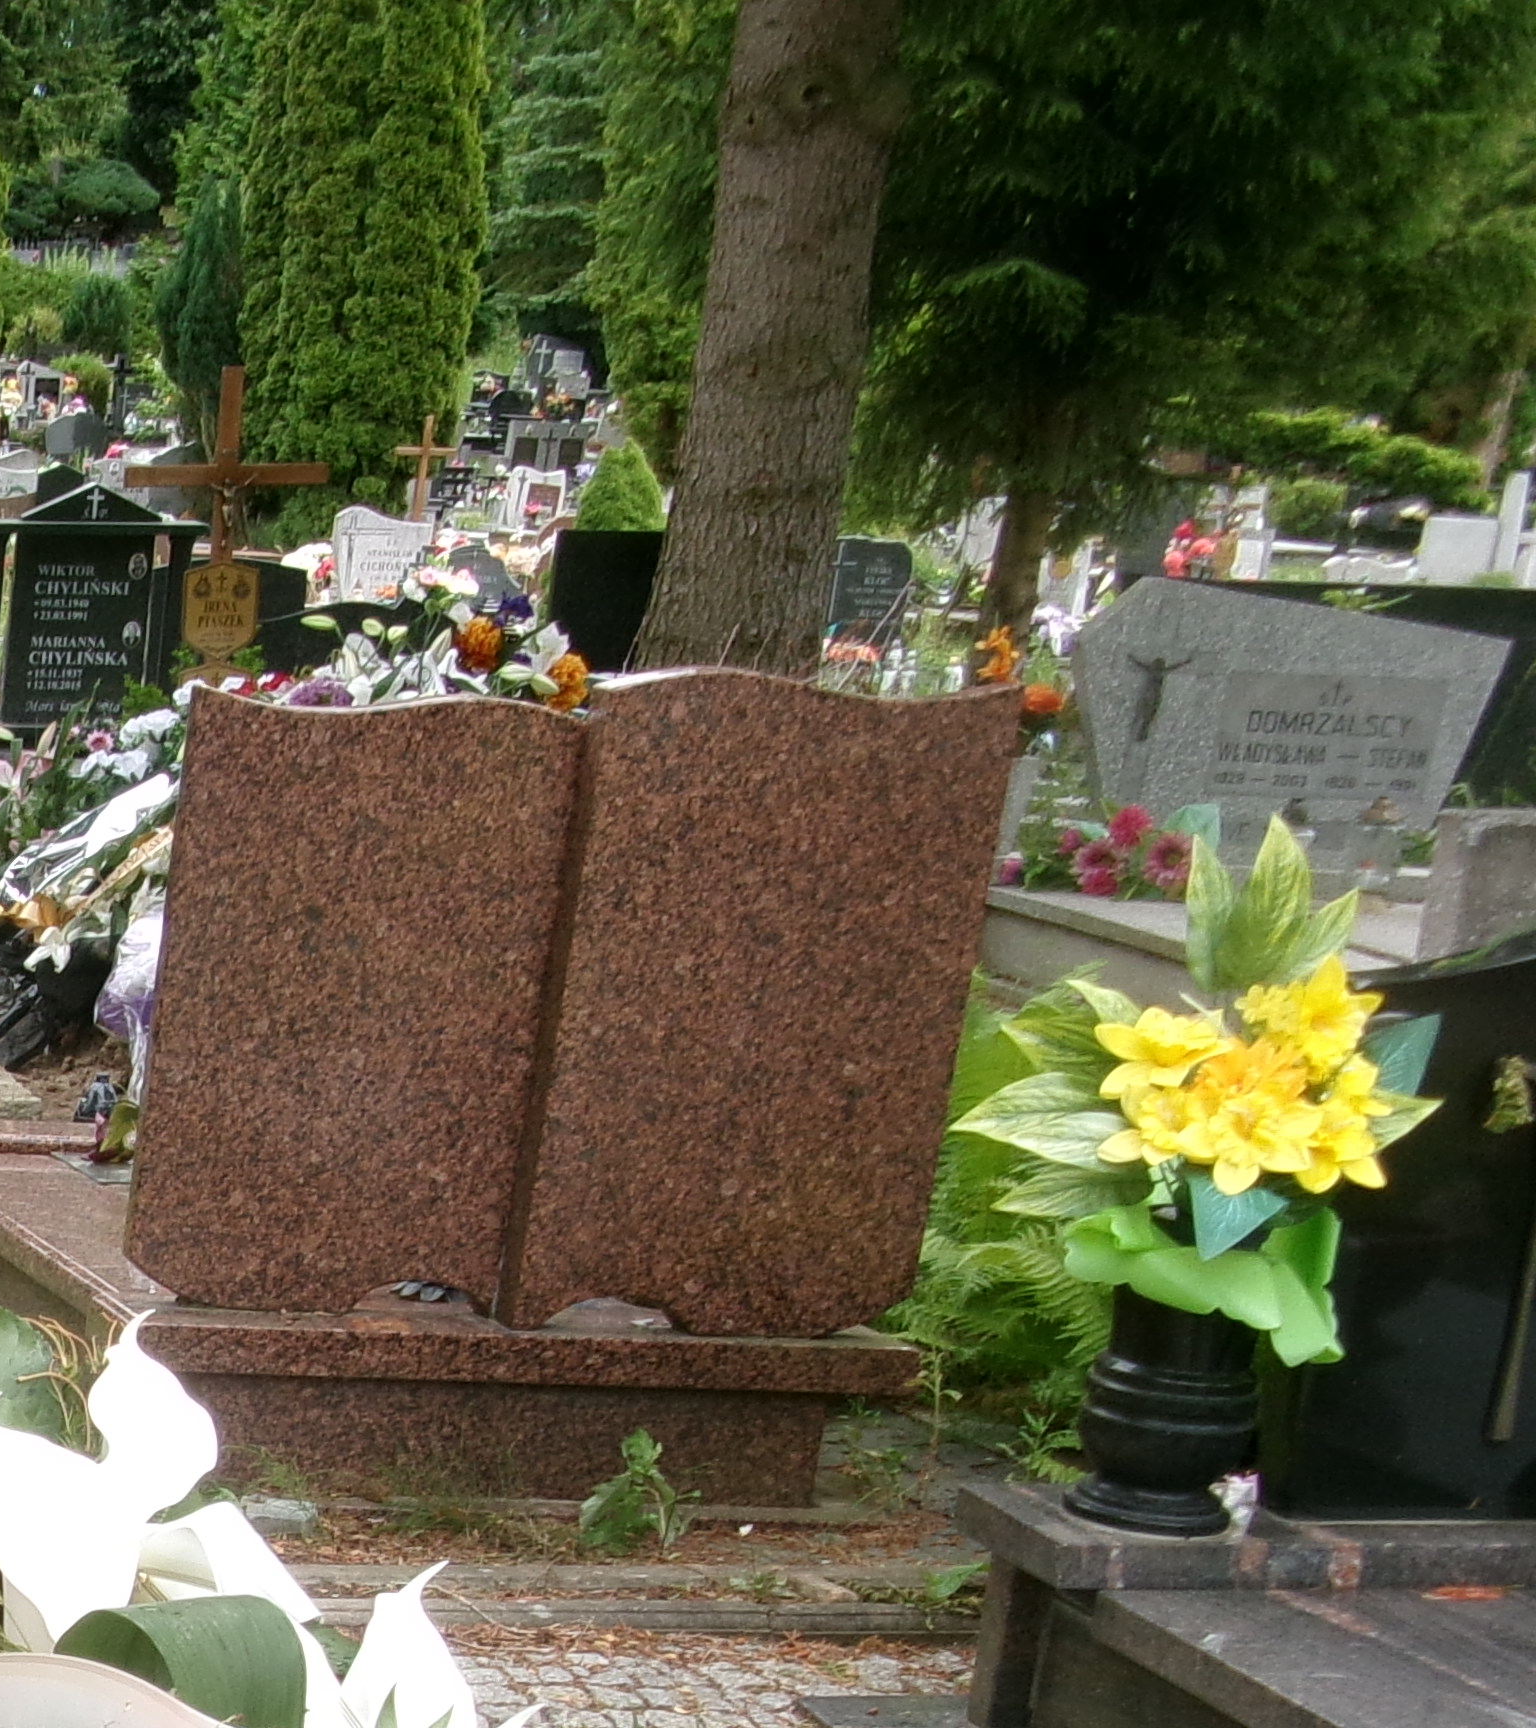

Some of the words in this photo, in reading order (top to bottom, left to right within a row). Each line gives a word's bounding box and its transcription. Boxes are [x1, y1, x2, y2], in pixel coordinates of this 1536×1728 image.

[38, 564, 95, 577] WIKTOR
[34, 578, 129, 596] CHYLIŃSKI
[30, 636, 105, 649] MARIANNA
[29, 648, 128, 666] CHYLIŃSKA
[1246, 710, 1413, 738] DOMRZALSCY
[1218, 742, 1326, 766] WŁADYSŁAWA
[1366, 748, 1429, 769] STEFAN
